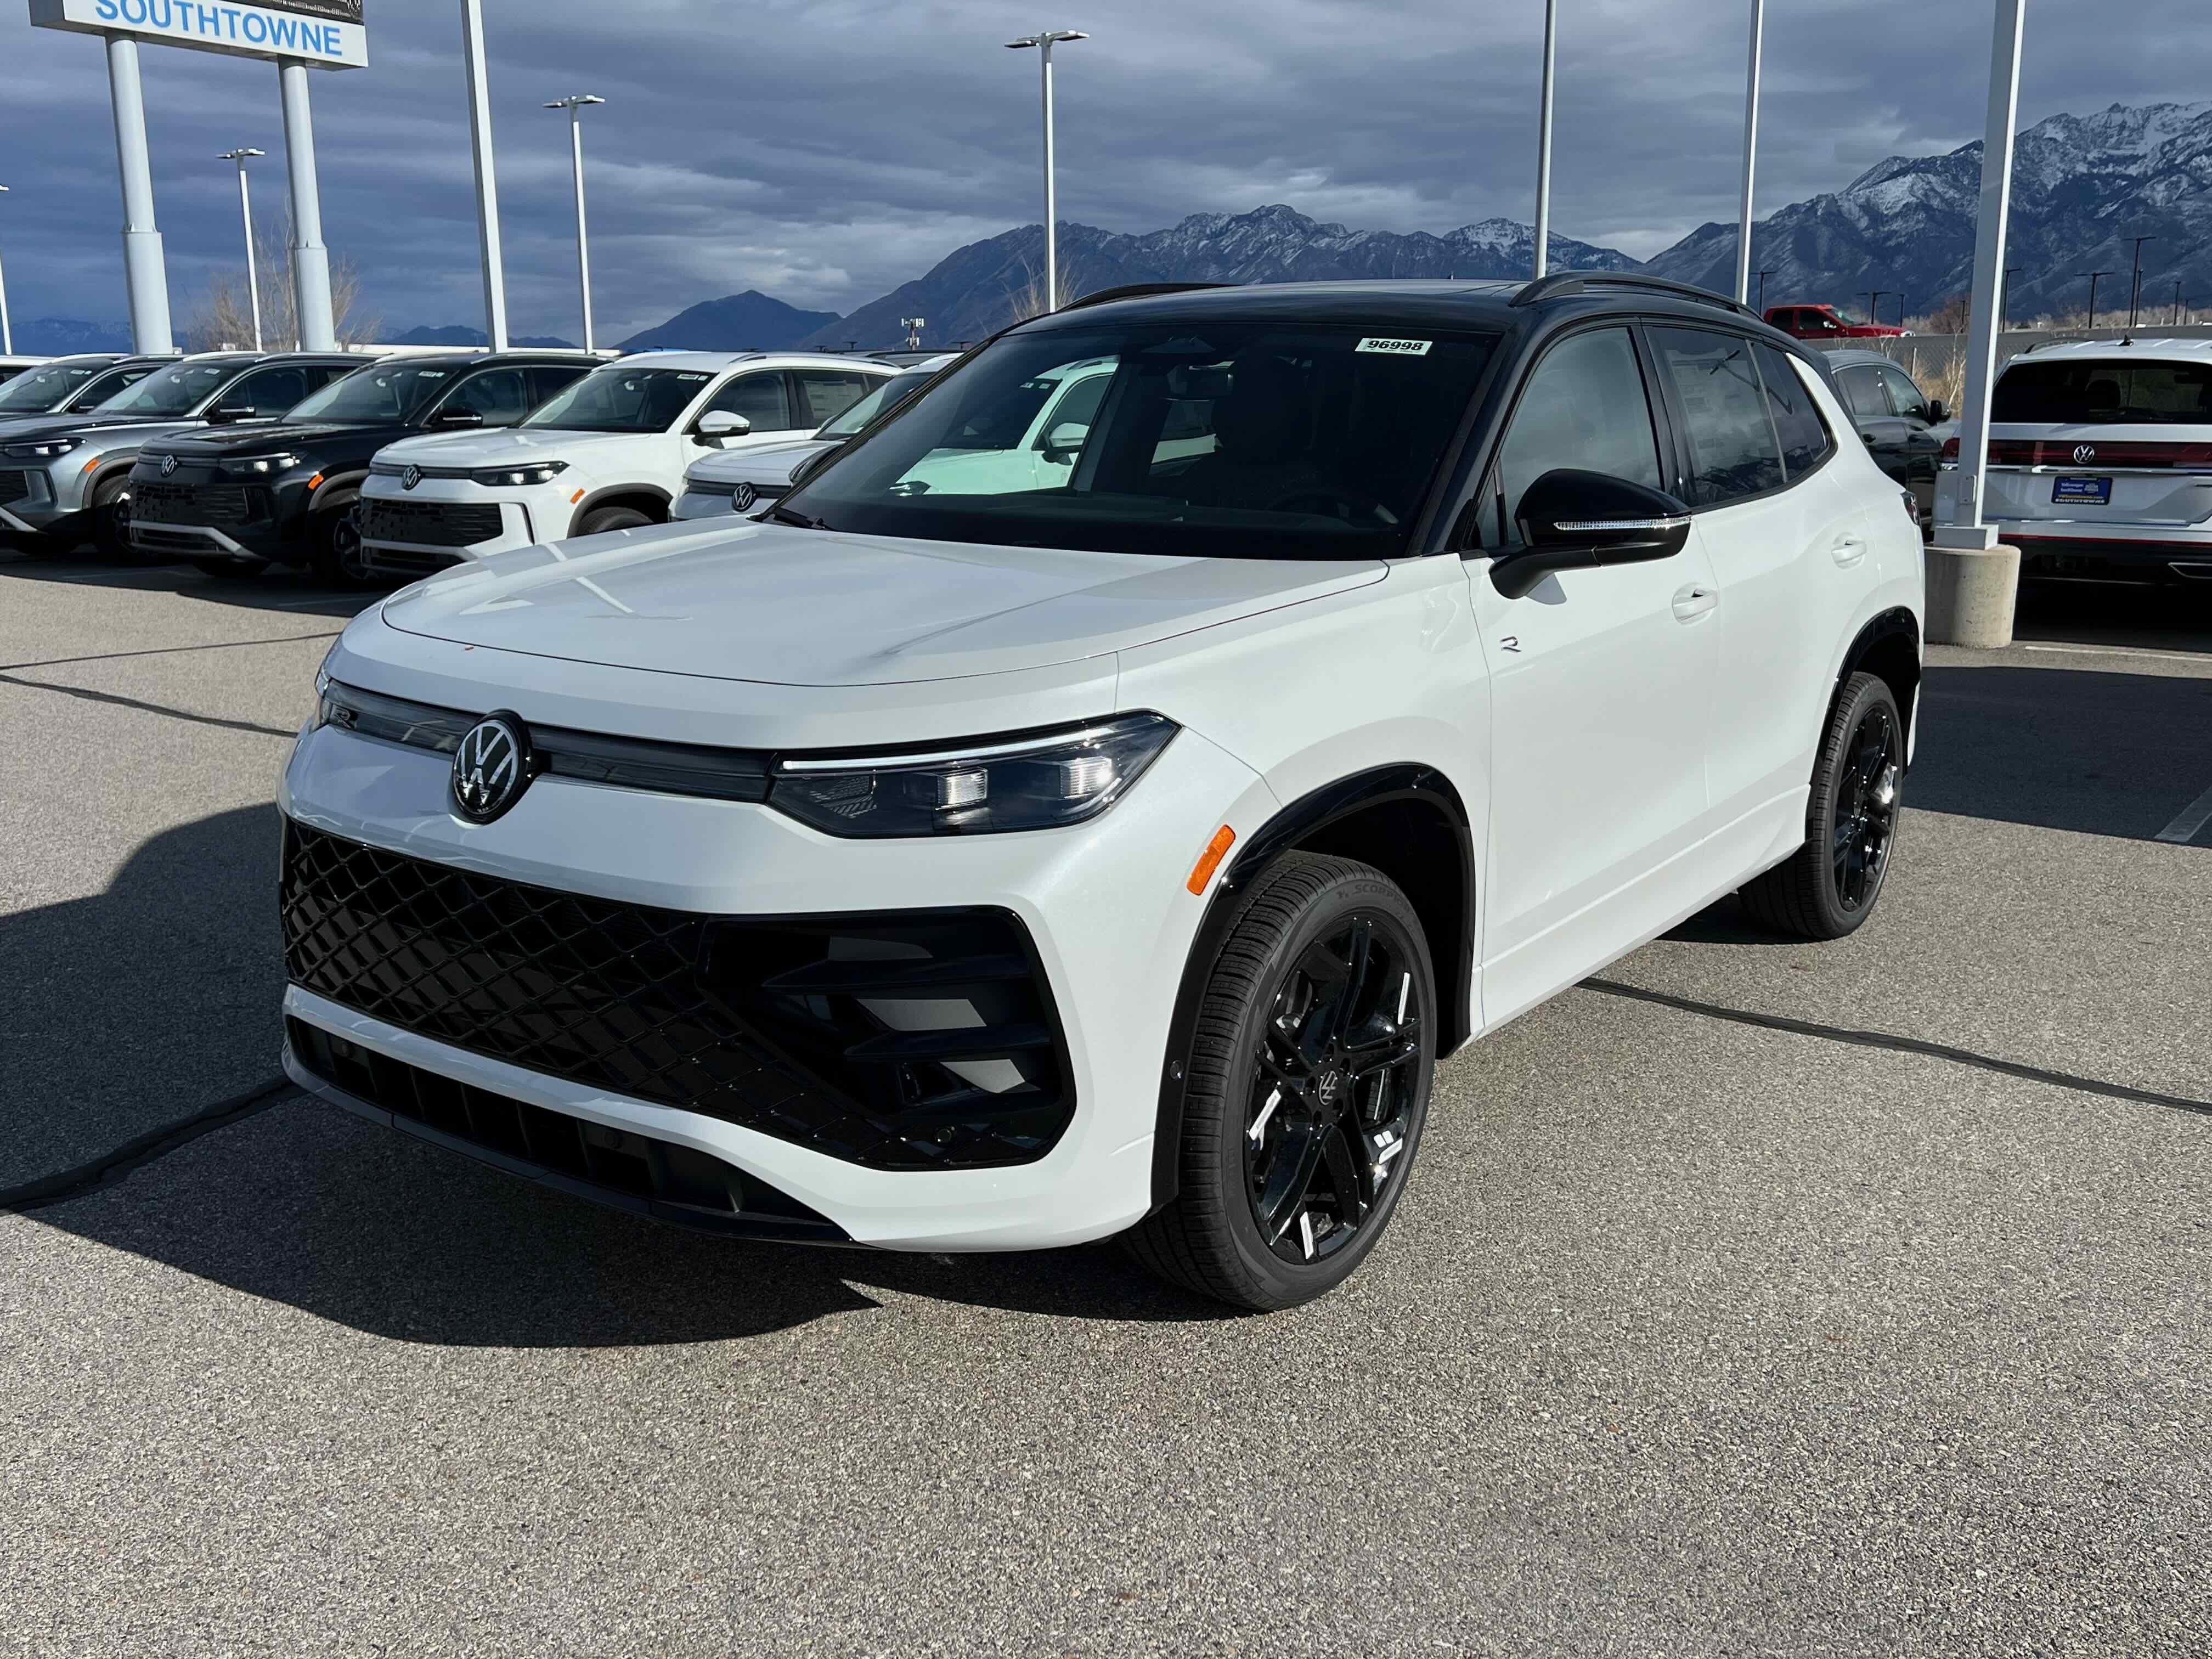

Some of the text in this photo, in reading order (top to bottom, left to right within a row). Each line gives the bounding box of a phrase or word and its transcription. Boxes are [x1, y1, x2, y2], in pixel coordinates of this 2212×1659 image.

[96, 0, 342, 56] SOUTHTOWNE
[1367, 340, 1424, 351] 96998
[1500, 636, 1522, 652] R
[1352, 884, 1411, 912] SCORP
